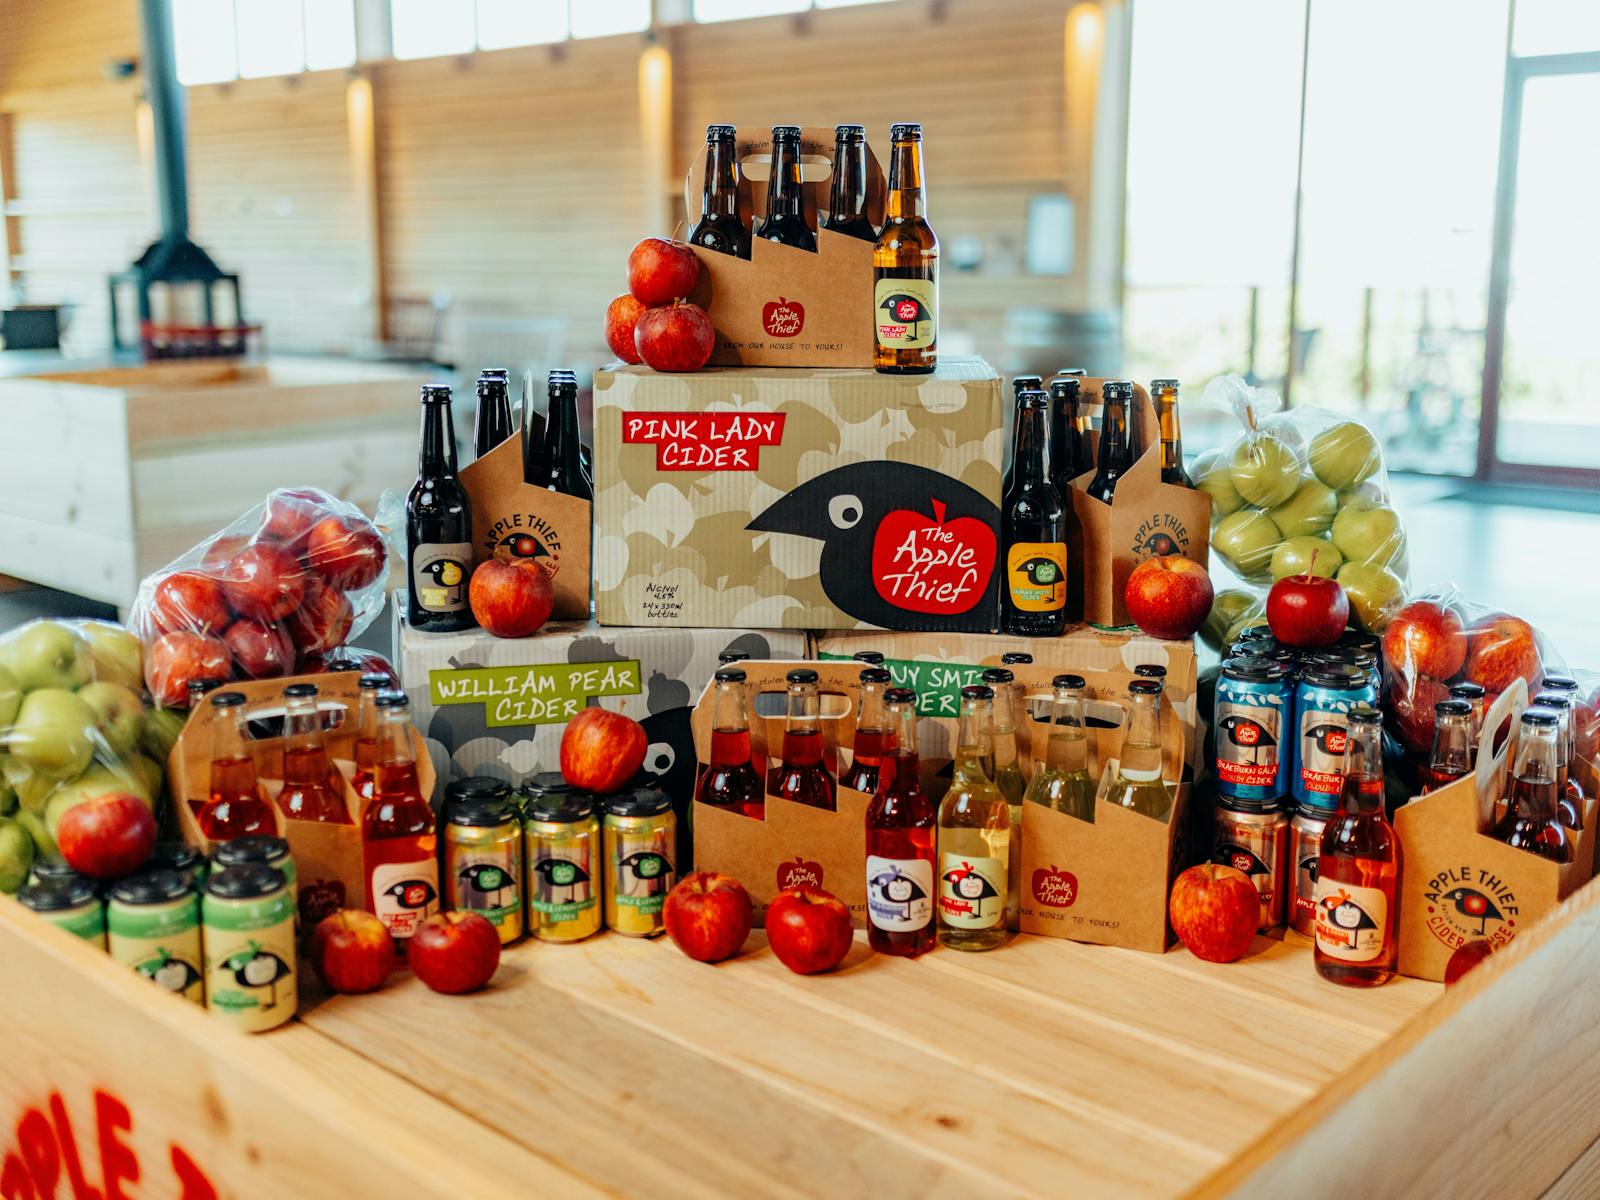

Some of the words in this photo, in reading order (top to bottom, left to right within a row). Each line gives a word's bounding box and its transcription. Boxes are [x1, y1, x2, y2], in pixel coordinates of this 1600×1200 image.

[770, 309, 800, 324] Apple
[767, 320, 800, 334] Thief
[628, 418, 698, 440] PINK
[710, 415, 775, 443] LADY
[662, 442, 750, 468] CIDER
[484, 514, 522, 551] APPLE
[528, 514, 561, 551] THIEF
[921, 526, 955, 543] The
[1131, 513, 1161, 555] APPLE
[1164, 513, 1189, 546] THIEF
[892, 530, 977, 575] Apple
[882, 568, 978, 603] Thief
[654, 592, 675, 600] 4.5%
[648, 610, 678, 618] bottles
[660, 602, 683, 610] 330ml
[437, 670, 556, 698] WILLIAM
[569, 666, 634, 692] PEAR
[927, 667, 984, 689] SMI
[495, 697, 578, 721] CIDER
[1238, 735, 1257, 743] Thief
[1239, 729, 1258, 739] Apple
[1217, 759, 1256, 774] BRAEBURN
[1257, 766, 1277, 775] GALA
[1246, 775, 1272, 784] CIDER
[1303, 770, 1341, 783] BRAEBUR
[786, 869, 817, 885] Apple
[1040, 877, 1071, 893] Apple
[1037, 890, 1073, 904] Thief
[1424, 867, 1471, 904] APPLE
[1479, 869, 1519, 916] THIEF
[1297, 899, 1314, 909] APPLE
[1039, 911, 1065, 921] HOUSE
[1071, 916, 1084, 924] TO
[1089, 919, 1120, 929] YOURS!
[1430, 916, 1465, 950] CIDER
